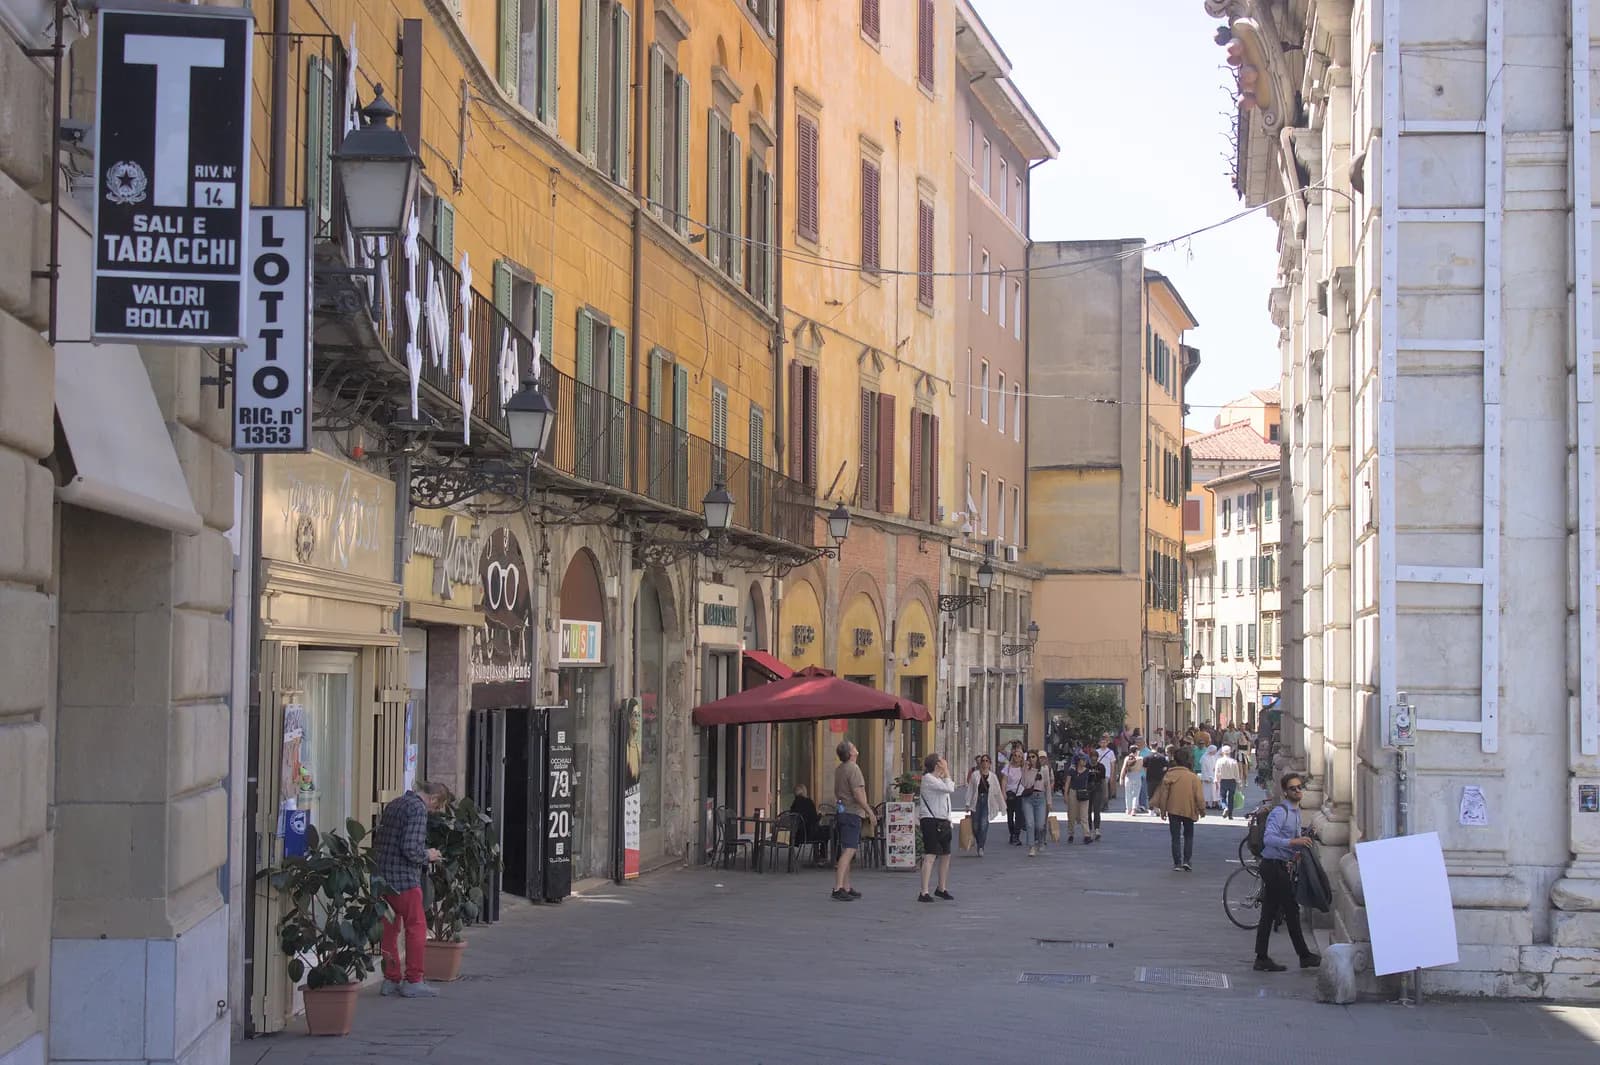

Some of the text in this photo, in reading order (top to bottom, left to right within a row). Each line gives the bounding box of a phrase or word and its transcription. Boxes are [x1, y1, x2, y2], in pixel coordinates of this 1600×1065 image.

[123, 33, 226, 208] T
[195, 165, 220, 178] RIV.
[204, 187, 224, 206] 14
[133, 214, 207, 235] SALI E
[104, 234, 236, 266] TABACCHI
[132, 284, 205, 306] VALORI
[252, 215, 291, 399] LOTTO
[125, 307, 210, 330] BOLLATI
[239, 407, 278, 425] RIC.
[241, 426, 291, 444] 1353
[563, 628, 596, 655] MUST
[508, 661, 532, 680] brands
